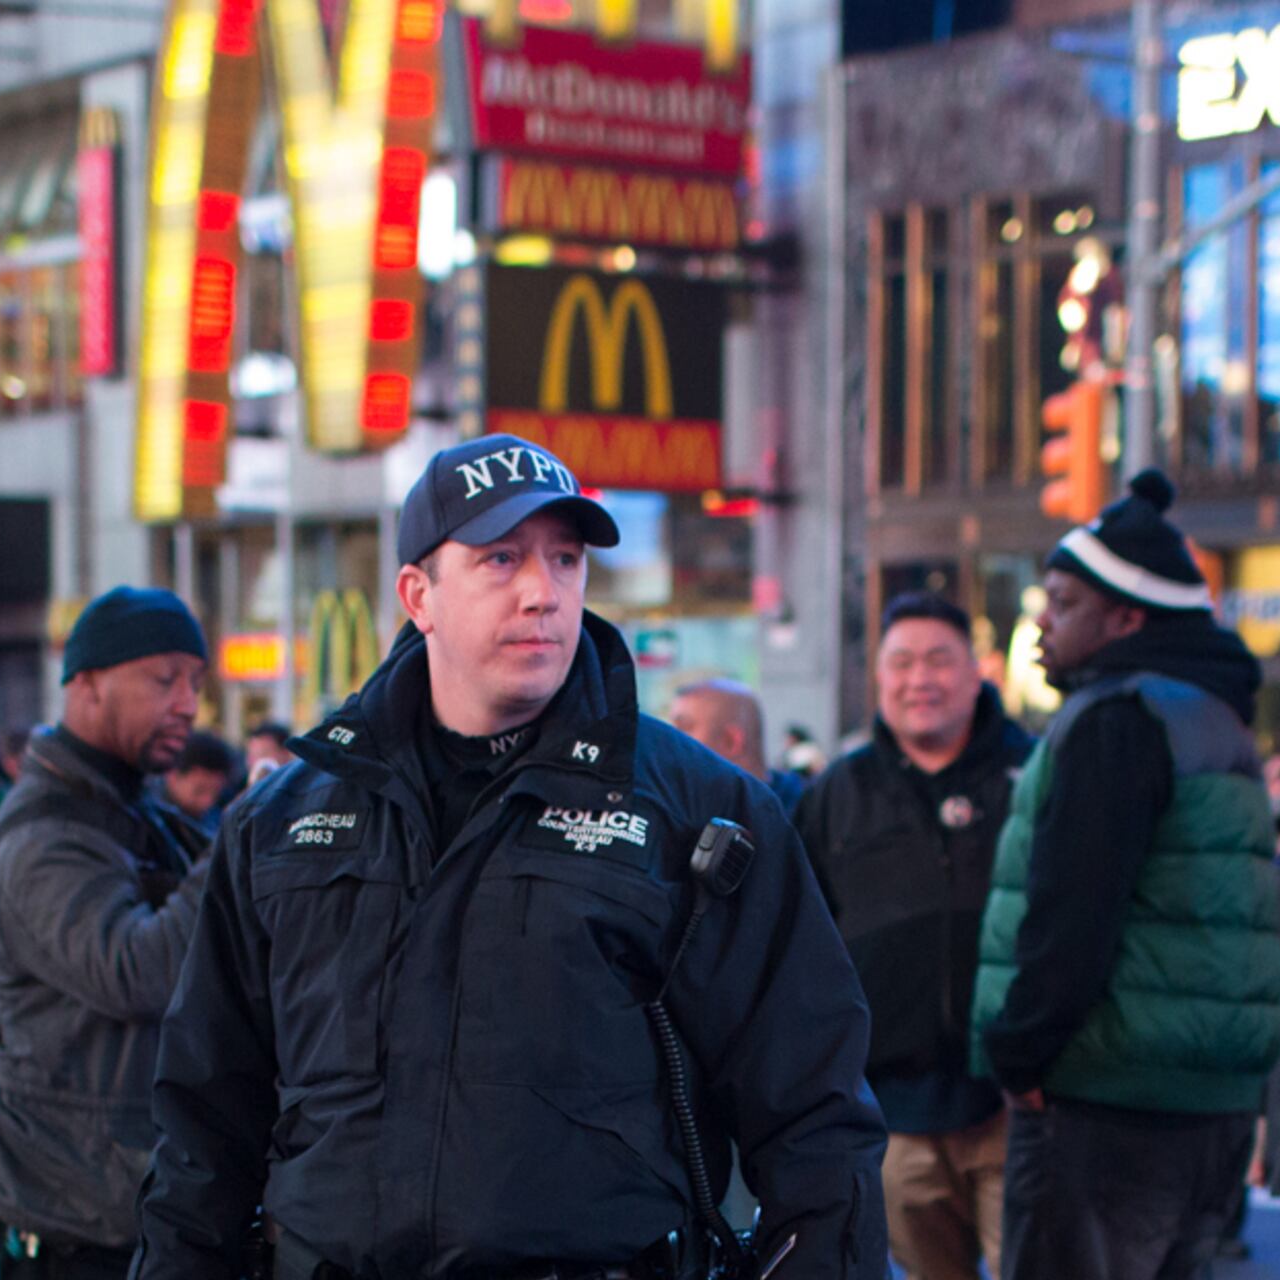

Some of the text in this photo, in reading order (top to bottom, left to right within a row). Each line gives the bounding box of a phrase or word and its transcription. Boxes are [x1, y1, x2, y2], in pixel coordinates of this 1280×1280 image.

[455, 447, 575, 499] NYPD
[572, 740, 600, 763] K9
[543, 806, 649, 836] POLICE
